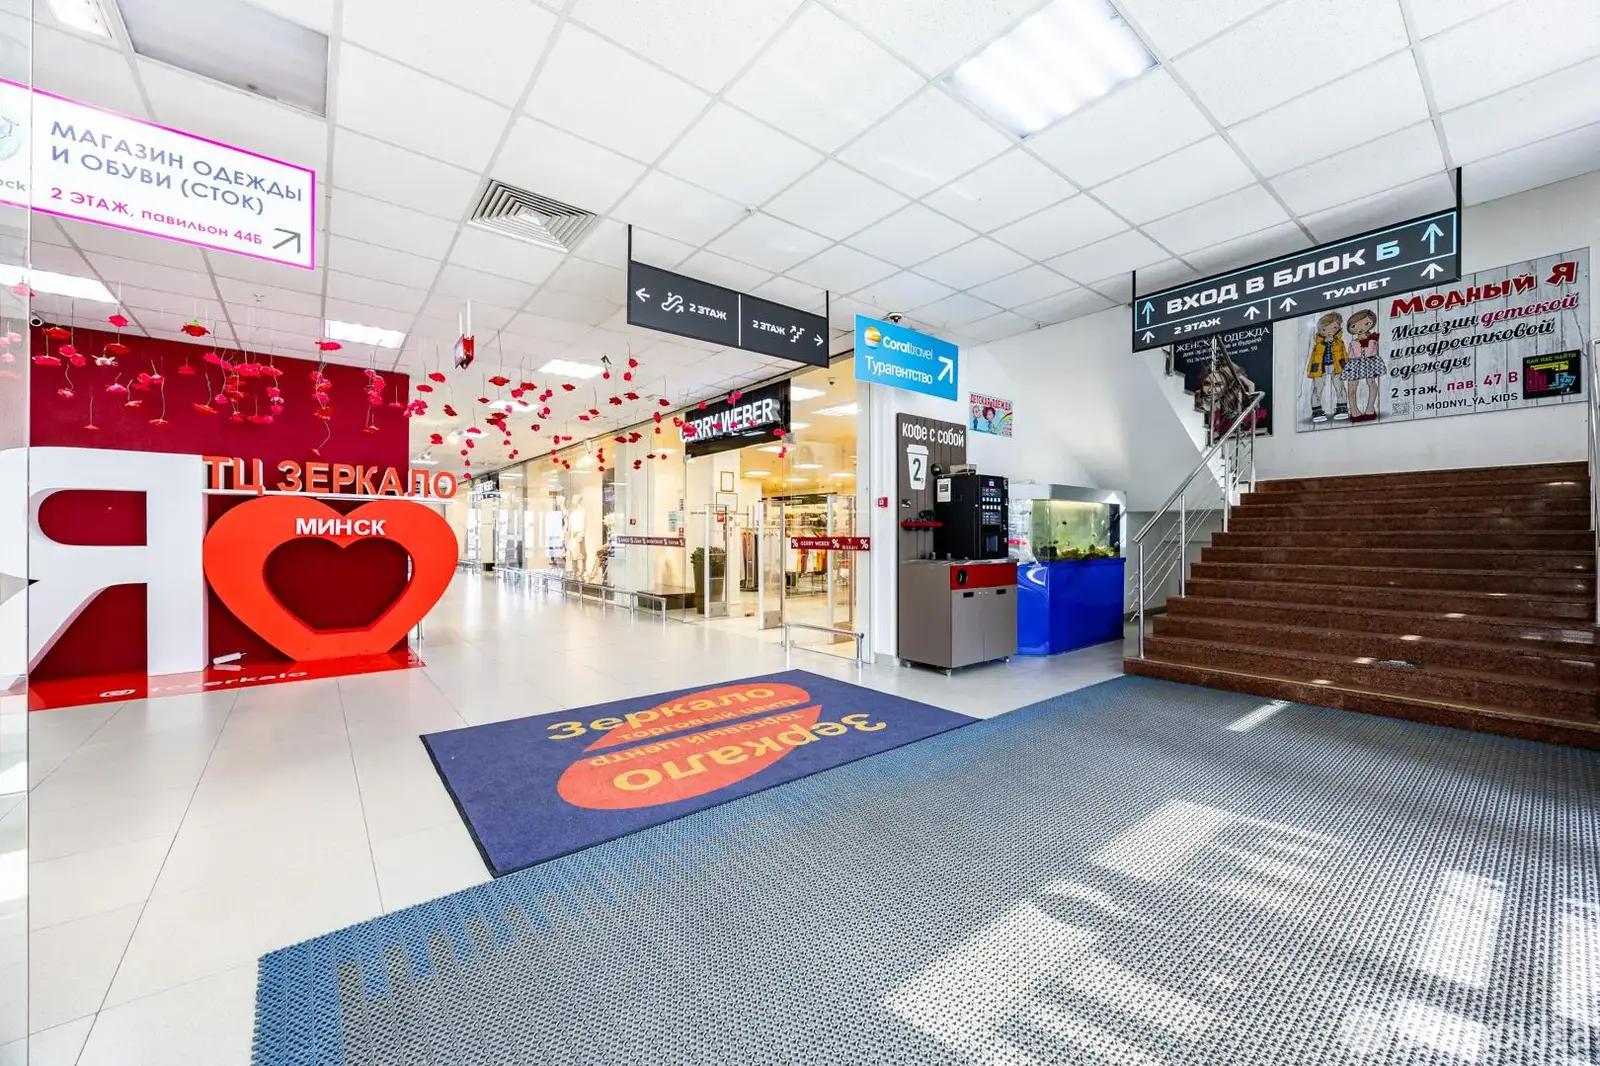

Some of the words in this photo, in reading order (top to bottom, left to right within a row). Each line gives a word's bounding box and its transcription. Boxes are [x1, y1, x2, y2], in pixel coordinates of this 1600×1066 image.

[50, 120, 184, 170] МАГАЗИН
[193, 160, 302, 202] ОДЕЖДЫ
[51, 145, 70, 164] И
[80, 153, 172, 190] ОБУВИ
[181, 178, 264, 216] (СТОК)
[51, 187, 62, 200] 2
[70, 192, 134, 217] ЭТАЖ,
[142, 209, 228, 238] павильон
[233, 230, 263, 245] 44Б
[1166, 283, 1238, 315] ВХОД
[1245, 276, 1265, 295] В
[1273, 248, 1366, 287] БЛОК
[1376, 240, 1400, 261] Б
[1322, 277, 1391, 300] ТУАЛЕТ
[1545, 260, 1579, 287] Я
[689, 303, 697, 312] 2
[697, 304, 727, 321] ЭТАЖ
[752, 320, 760, 328] 2
[760, 321, 786, 335] ЭТАЖ
[1173, 326, 1182, 335] 2
[1184, 317, 1221, 332] ЭТАЖ
[1391, 314, 1479, 341] Магазин
[1480, 292, 1579, 328] детской
[1224, 326, 1270, 342] ОДЕЖДА
[1390, 347, 1402, 360] и
[1403, 317, 1555, 357] подростковой
[865, 355, 933, 385] Турагентство
[1390, 355, 1471, 380] одежды
[1391, 387, 1399, 398] 2
[1403, 384, 1442, 397] этаж,
[1446, 379, 1478, 391] пав.
[1483, 372, 1502, 386] 47
[1508, 371, 1518, 383] В
[721, 398, 775, 433] WEBER
[1426, 392, 1518, 411] MODNYI_YA_KIDS
[202, 455, 266, 496] ТЦ
[277, 460, 458, 499] ЗЕРКАЛО
[296, 518, 386, 536] МИНСК
[0, 446, 207, 690] Я
[547, 688, 775, 741] Зеркало
[616, 710, 737, 742] торговый
[742, 698, 800, 716] центр
[684, 713, 805, 745] торговый
[589, 740, 681, 767] центр
[613, 713, 887, 792] Зеркало
